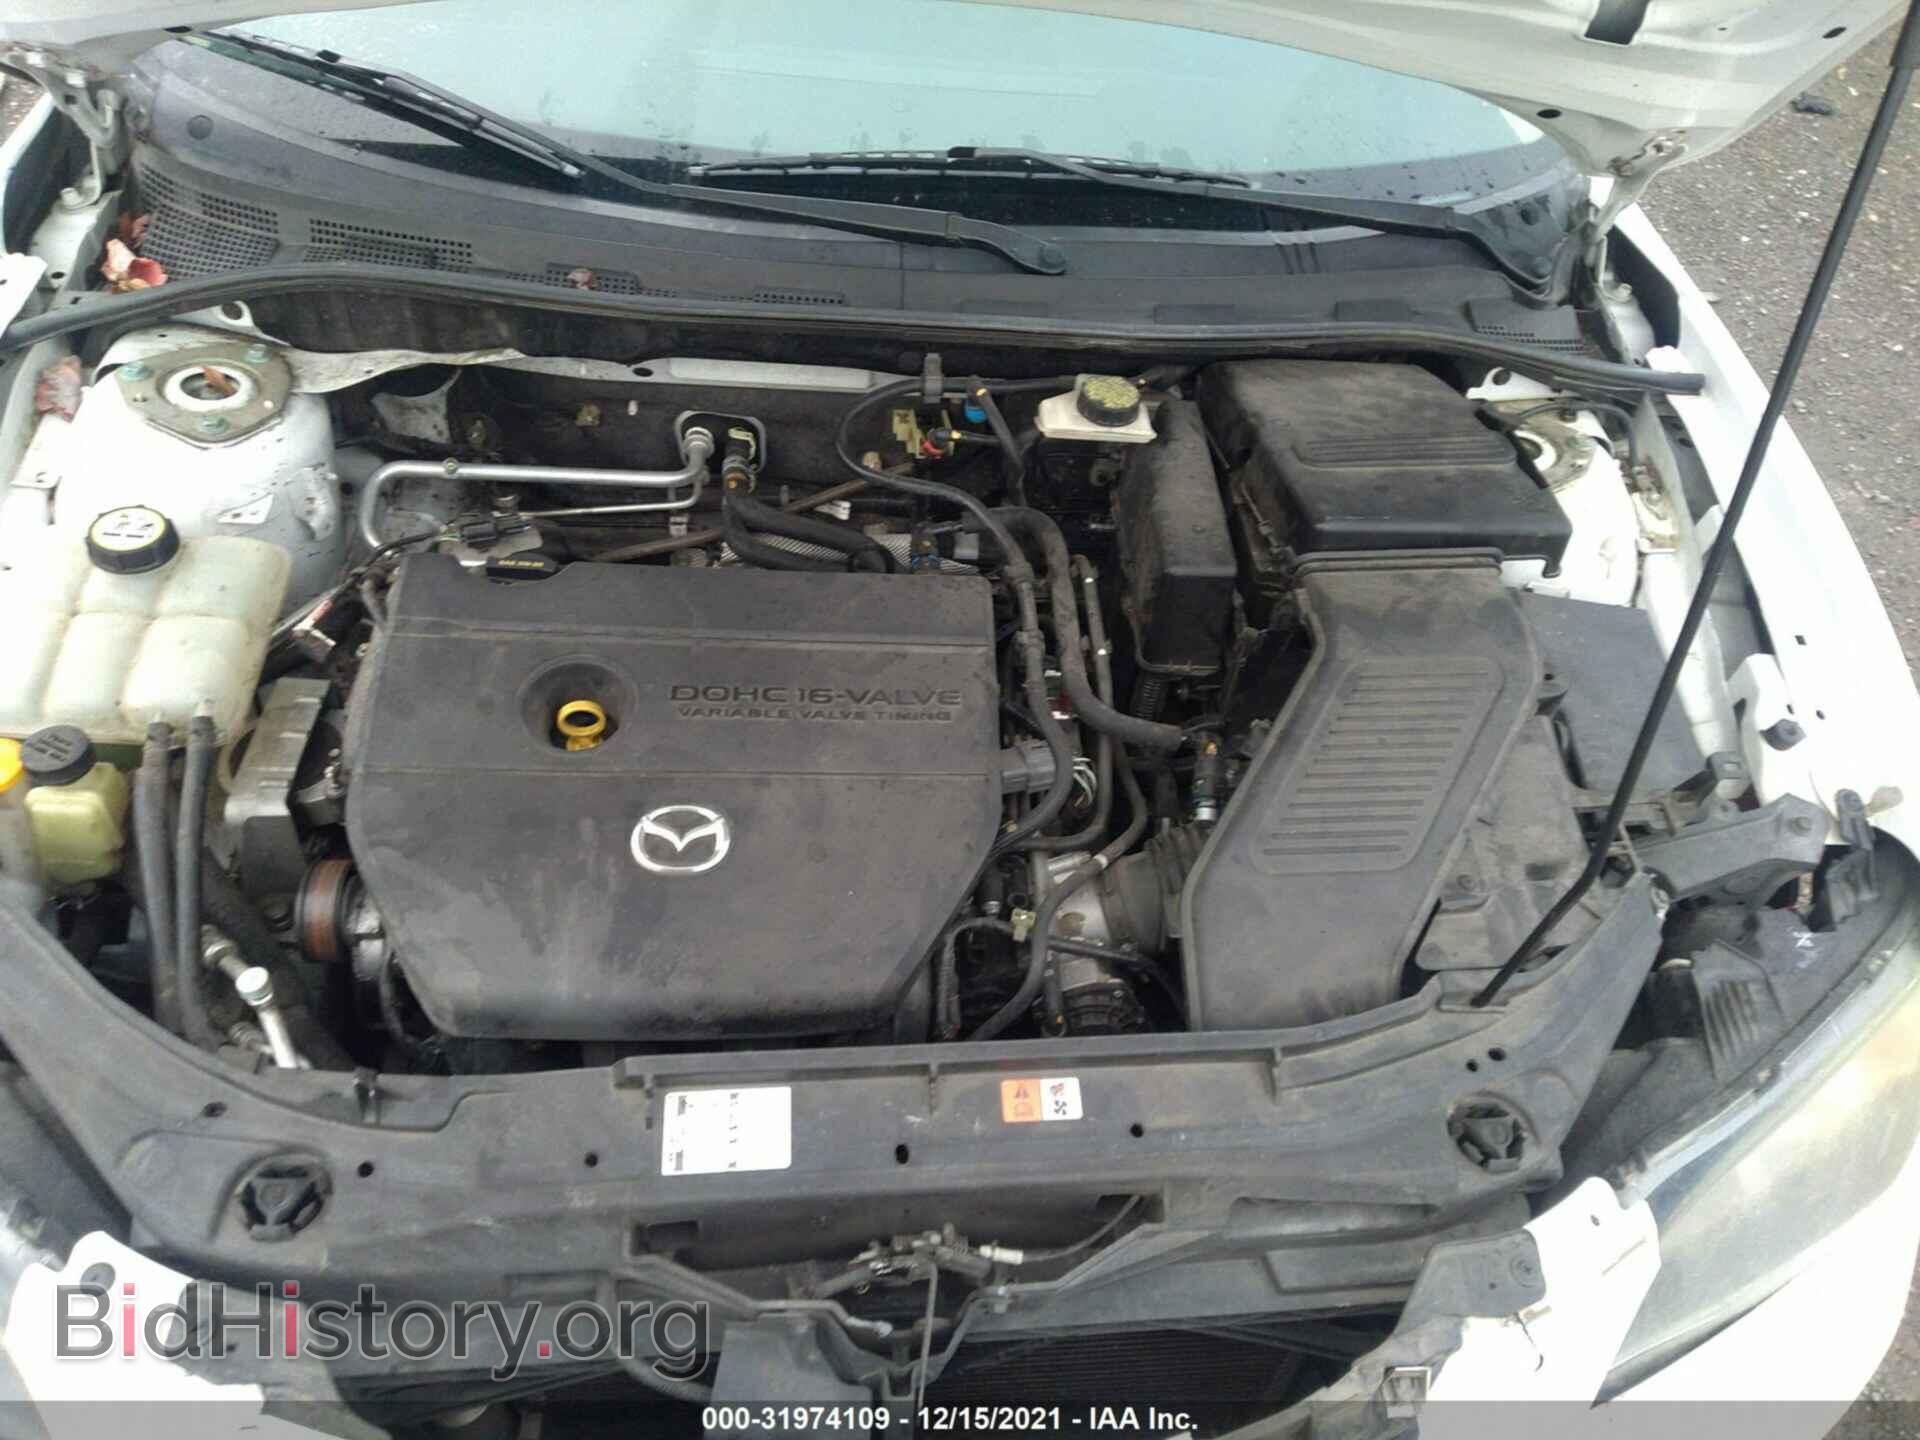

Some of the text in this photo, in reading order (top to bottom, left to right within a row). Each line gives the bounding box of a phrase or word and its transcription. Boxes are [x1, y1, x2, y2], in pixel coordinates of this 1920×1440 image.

[670, 685, 961, 706] DOHC 16-VALVE
[678, 705, 952, 722] VARIABLE VALVE TIMING
